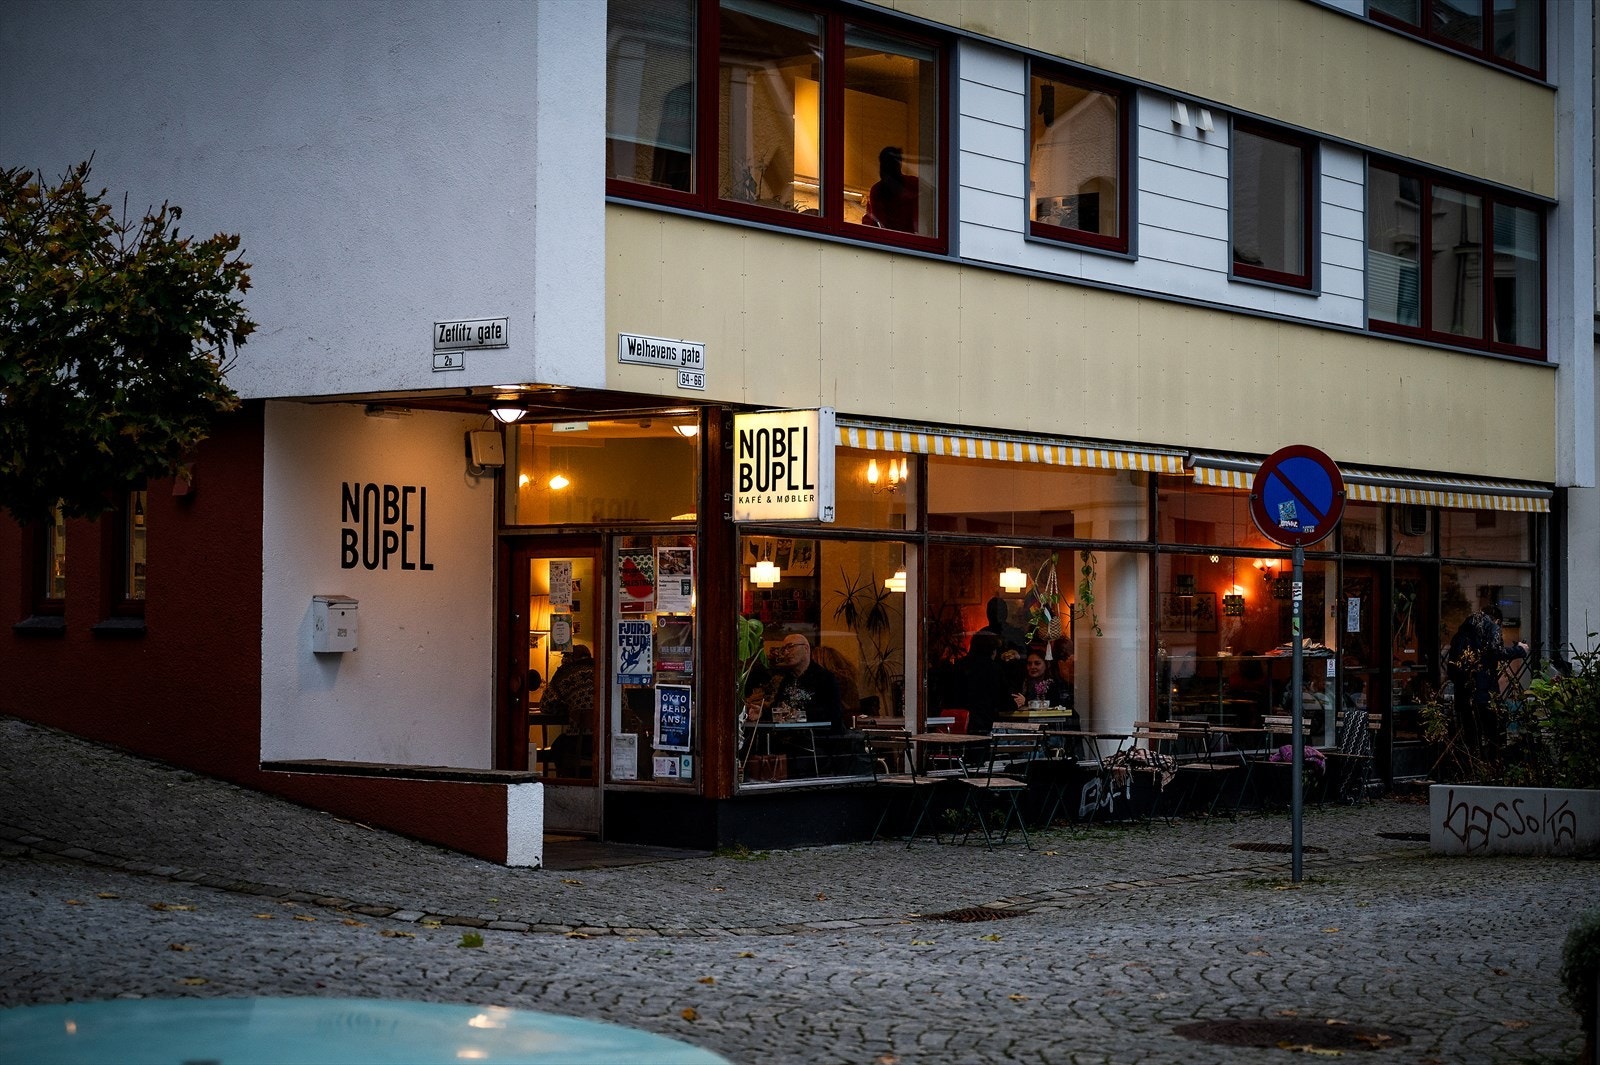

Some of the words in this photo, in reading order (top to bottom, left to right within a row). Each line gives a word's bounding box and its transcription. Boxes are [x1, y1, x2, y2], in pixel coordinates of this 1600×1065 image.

[438, 322, 472, 344] Zetlitz
[478, 322, 502, 346] gate
[626, 338, 676, 362] Welhavens
[680, 346, 701, 366] gate
[682, 373, 702, 387] 64-66
[738, 495, 762, 504] KAFÉ
[766, 496, 772, 504] &
[776, 494, 815, 504] MØBLER
[618, 622, 651, 635] FJORD
[662, 694, 687, 704] OKTO
